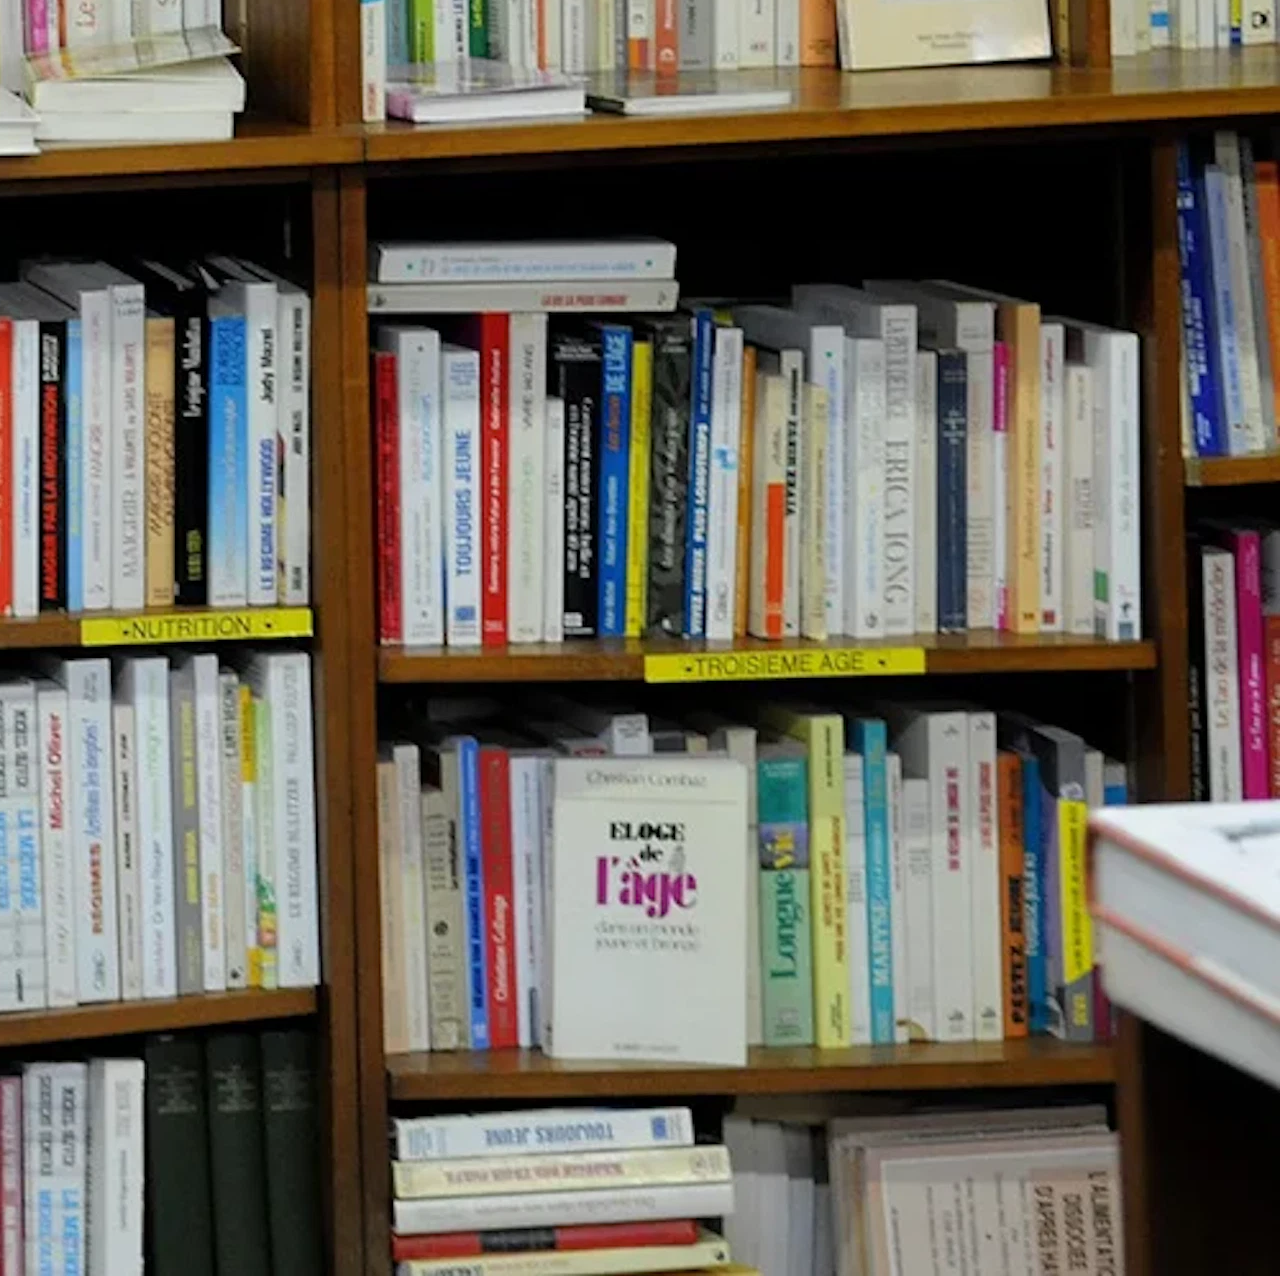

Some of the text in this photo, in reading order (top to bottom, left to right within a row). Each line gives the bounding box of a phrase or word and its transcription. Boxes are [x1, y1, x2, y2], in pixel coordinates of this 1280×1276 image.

[72, 3, 98, 27] Le
[259, 328, 275, 404] Judy Mazel
[43, 384, 58, 599] MAIGRIR PAR LA MOTIVATION
[260, 439, 273, 517] HOLLYWOOD
[454, 428, 473, 578] TOUJOURS JEUNE
[690, 423, 708, 634] VIVEZ MIEUX PLUS LONGTEMPS
[884, 440, 910, 603] ERICA JONG
[130, 616, 252, 640] NUTRITION
[1211, 639, 1229, 652] la
[694, 651, 865, 676] TROISIEME AGE
[1211, 656, 1229, 674] de
[1211, 711, 1229, 729] Le
[48, 712, 63, 831] Michel Oliver
[609, 821, 686, 841] ELOGE
[639, 844, 664, 863] de
[595, 855, 698, 919] l'âge
[769, 873, 800, 980] Longue
[874, 900, 889, 987] MARYSE
[484, 1120, 614, 1146] TOUJOURS JEUNE
